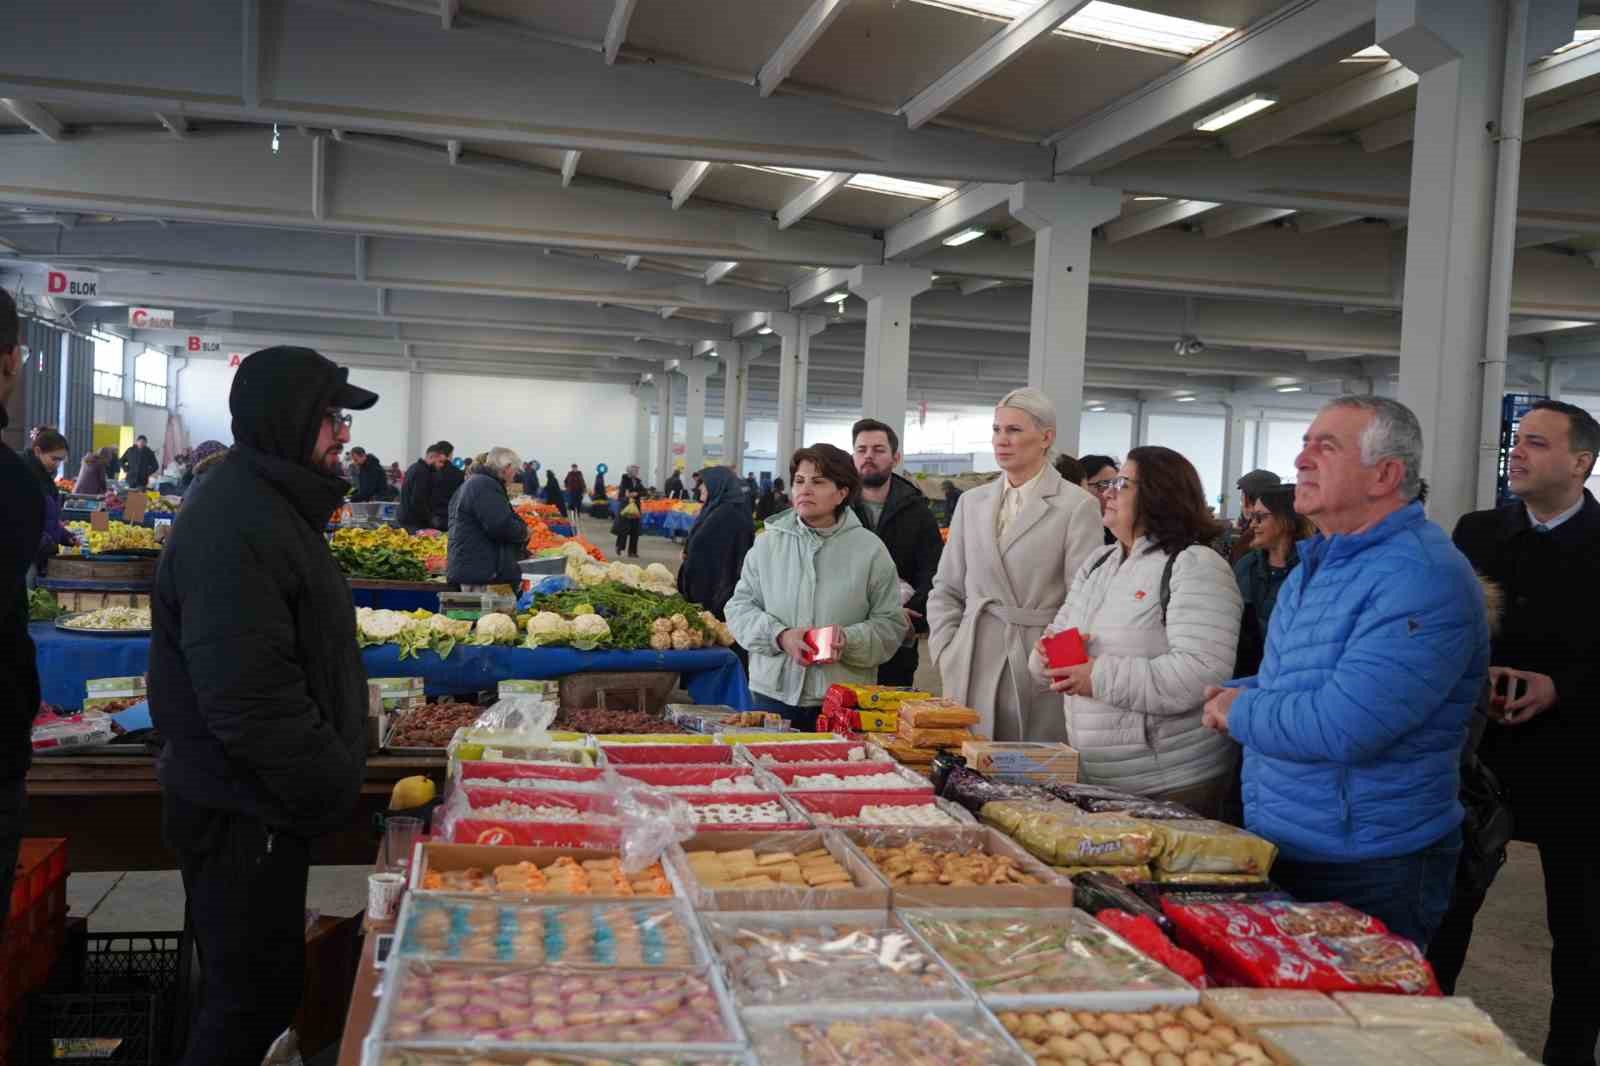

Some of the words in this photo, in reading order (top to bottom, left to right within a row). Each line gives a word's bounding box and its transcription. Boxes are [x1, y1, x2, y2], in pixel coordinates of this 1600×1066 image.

[48, 271, 66, 293] D
[70, 281, 96, 296] BLOK
[133, 310, 147, 327] C
[187, 336, 201, 351] B
[203, 342, 220, 352] BLOK
[230, 355, 240, 367] A
